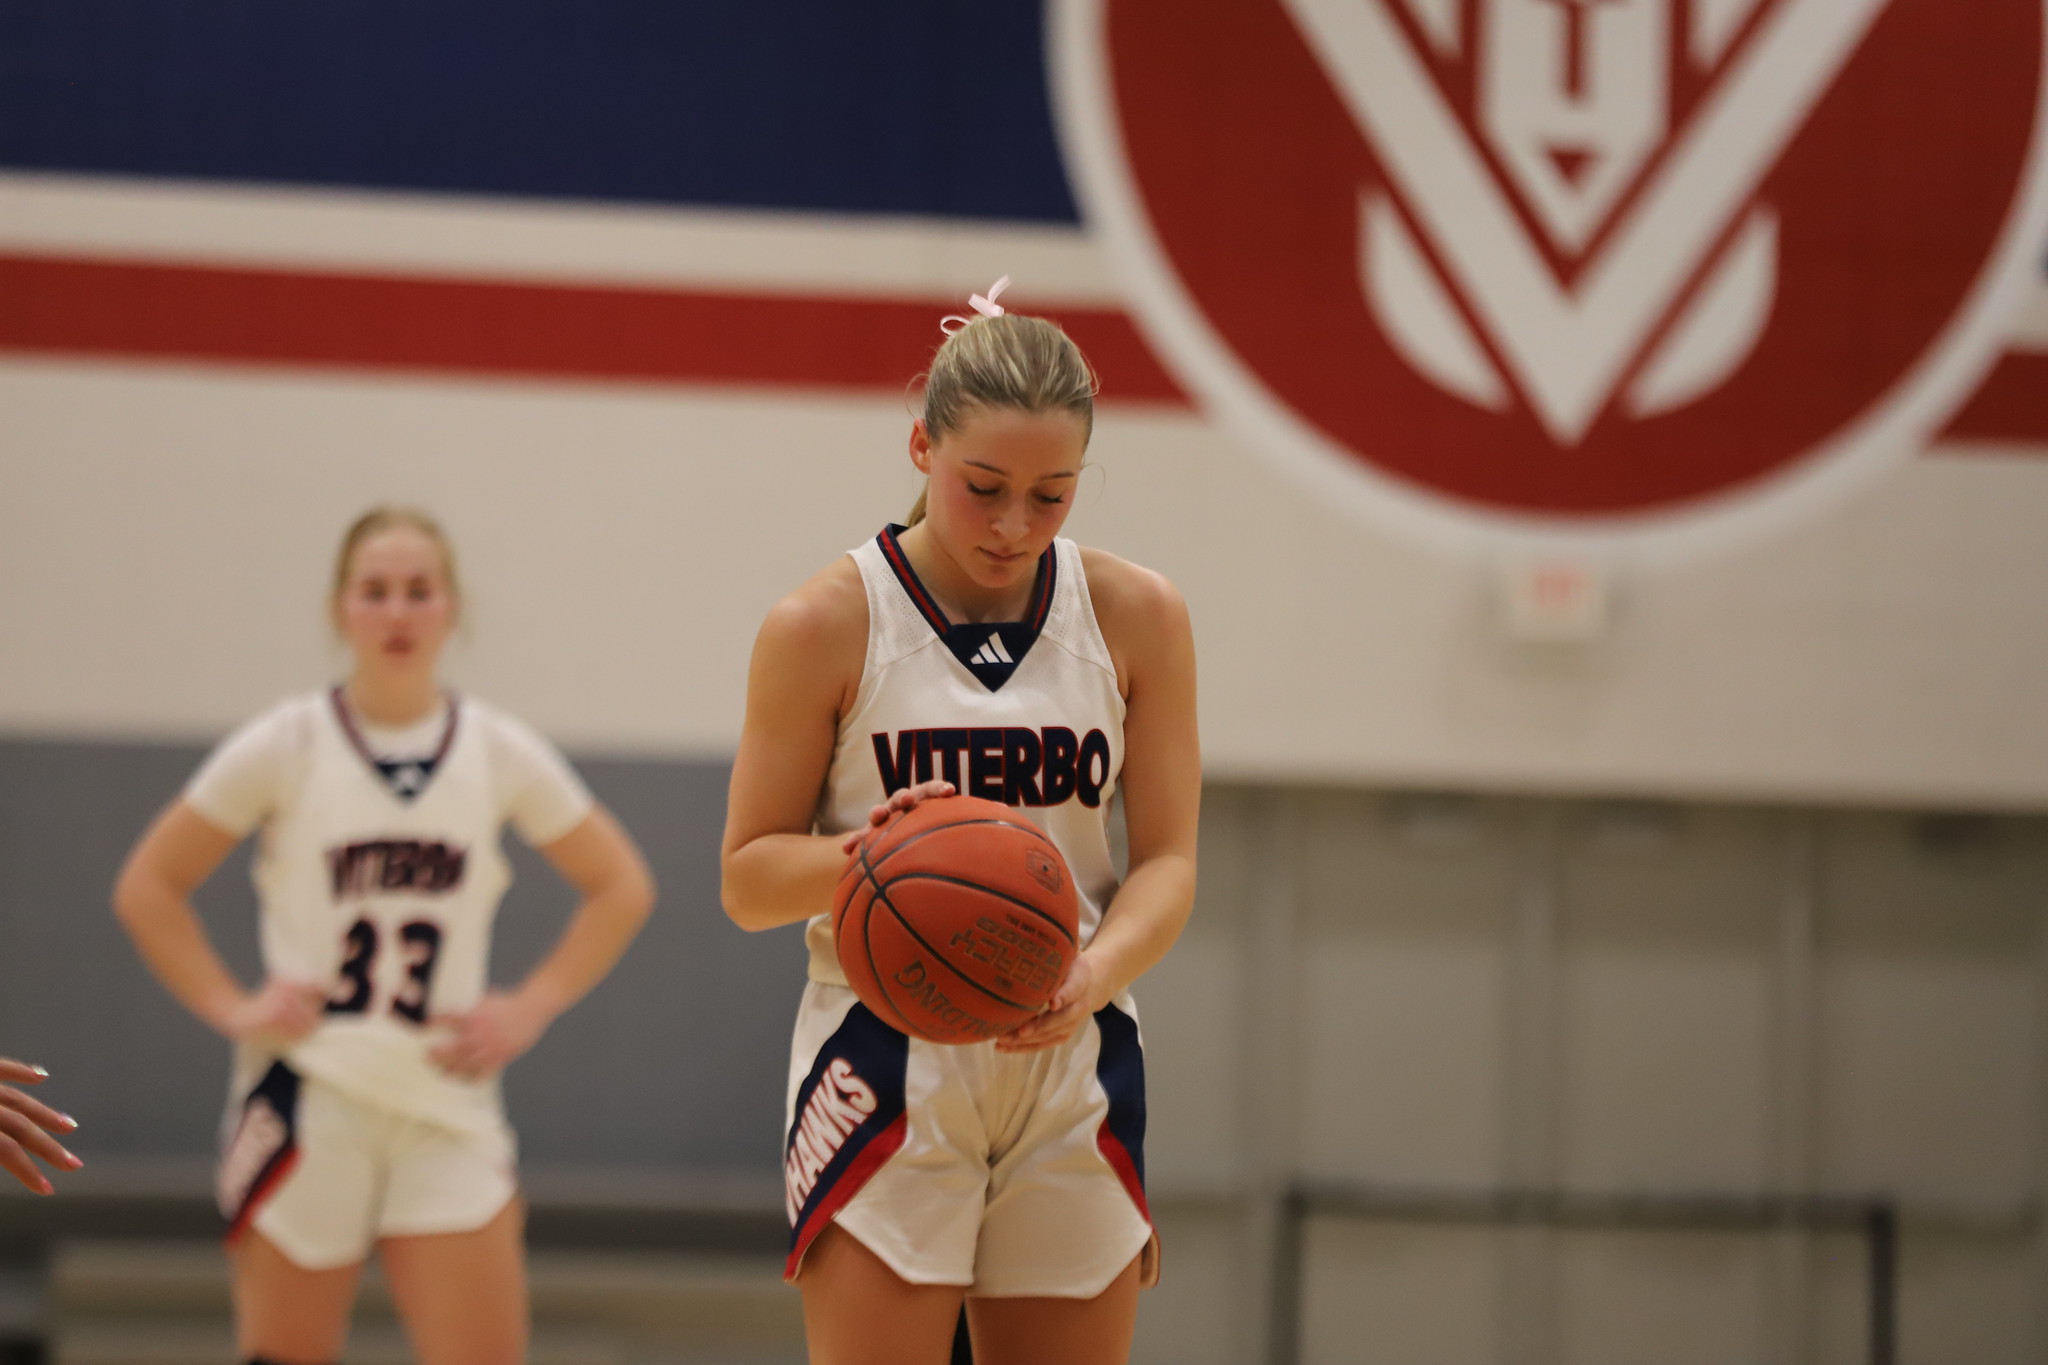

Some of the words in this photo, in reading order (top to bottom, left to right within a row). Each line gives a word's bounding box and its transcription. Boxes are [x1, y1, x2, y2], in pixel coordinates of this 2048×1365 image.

[871, 726, 1110, 809] VITERBO
[324, 917, 441, 1022] 33
[892, 959, 1014, 1038] ALDING
